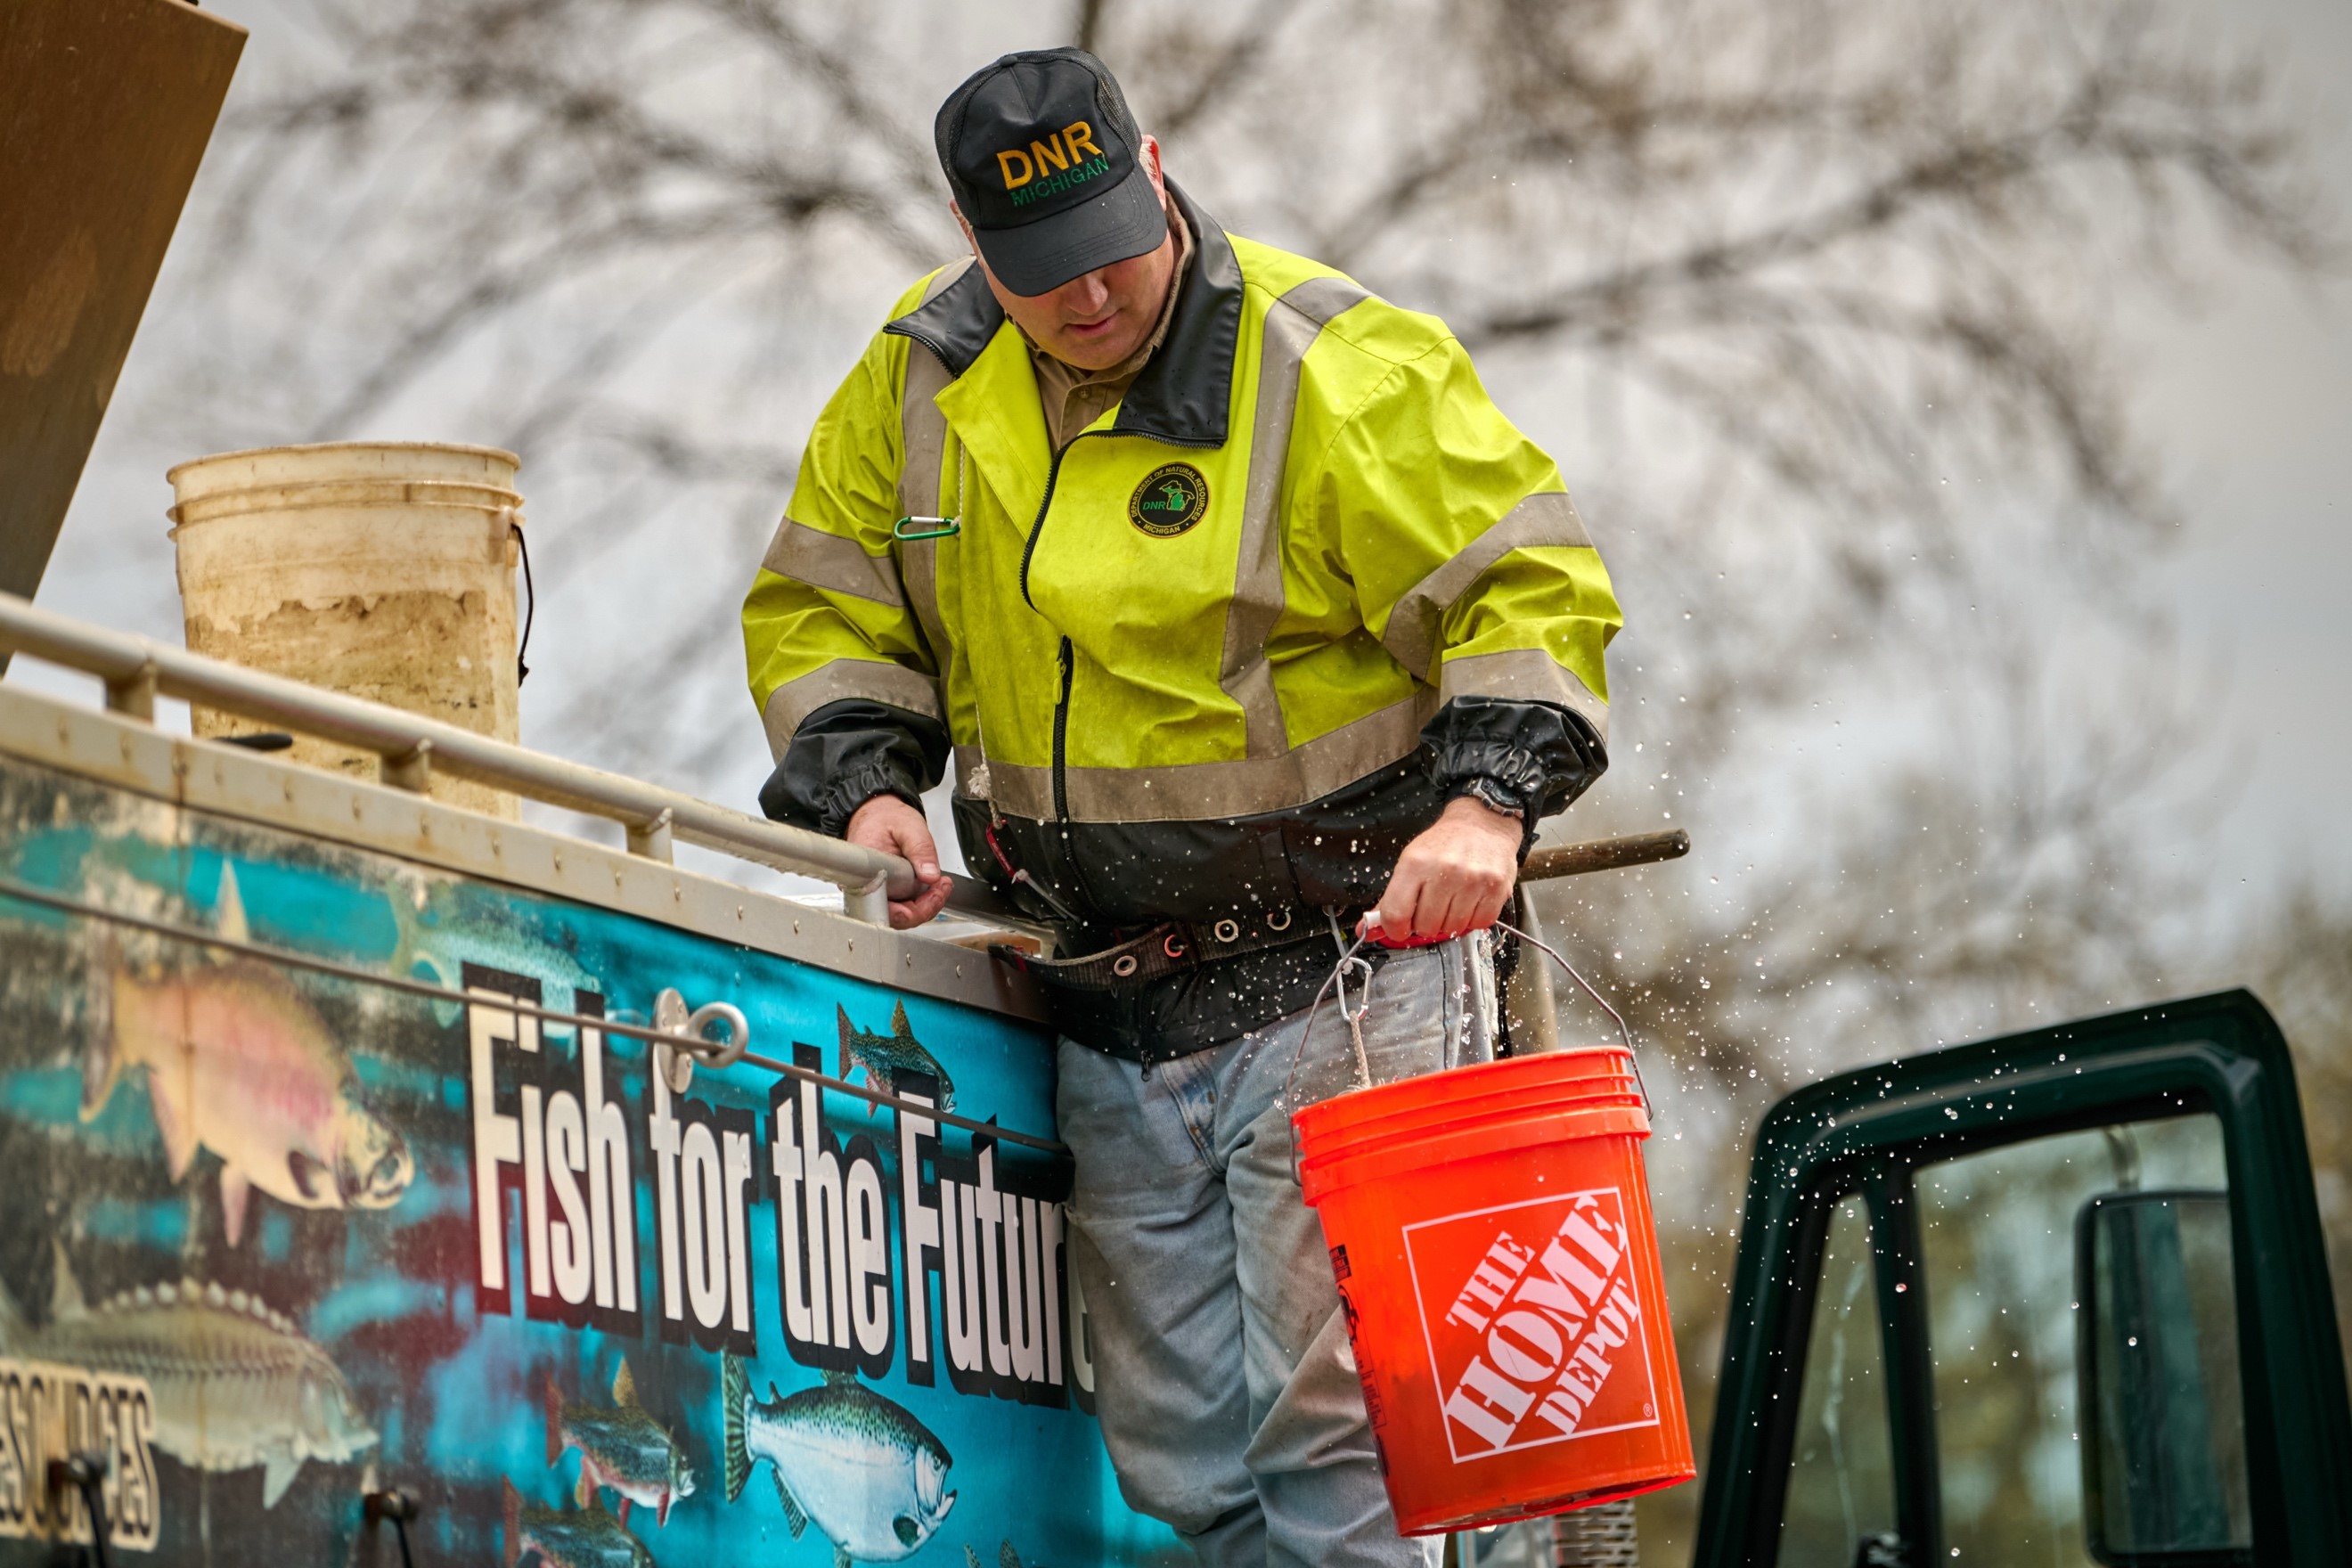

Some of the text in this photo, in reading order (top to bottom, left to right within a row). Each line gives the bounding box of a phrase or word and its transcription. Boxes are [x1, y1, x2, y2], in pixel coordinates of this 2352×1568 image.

[996, 121, 1102, 190] DNR
[1009, 156, 1110, 208] MICHIGAN
[1131, 466, 1206, 521] DEPARTMENT OF NATURAL RESOURCES
[1142, 501, 1166, 510] DNR
[1143, 524, 1180, 535] MICHIGAN
[468, 985, 637, 1313] Fish
[649, 1033, 753, 1333] for
[772, 1068, 890, 1356] the
[1445, 1230, 1537, 1335] THE
[1445, 1194, 1628, 1450] HOME
[1535, 1277, 1640, 1436] DEPOT
